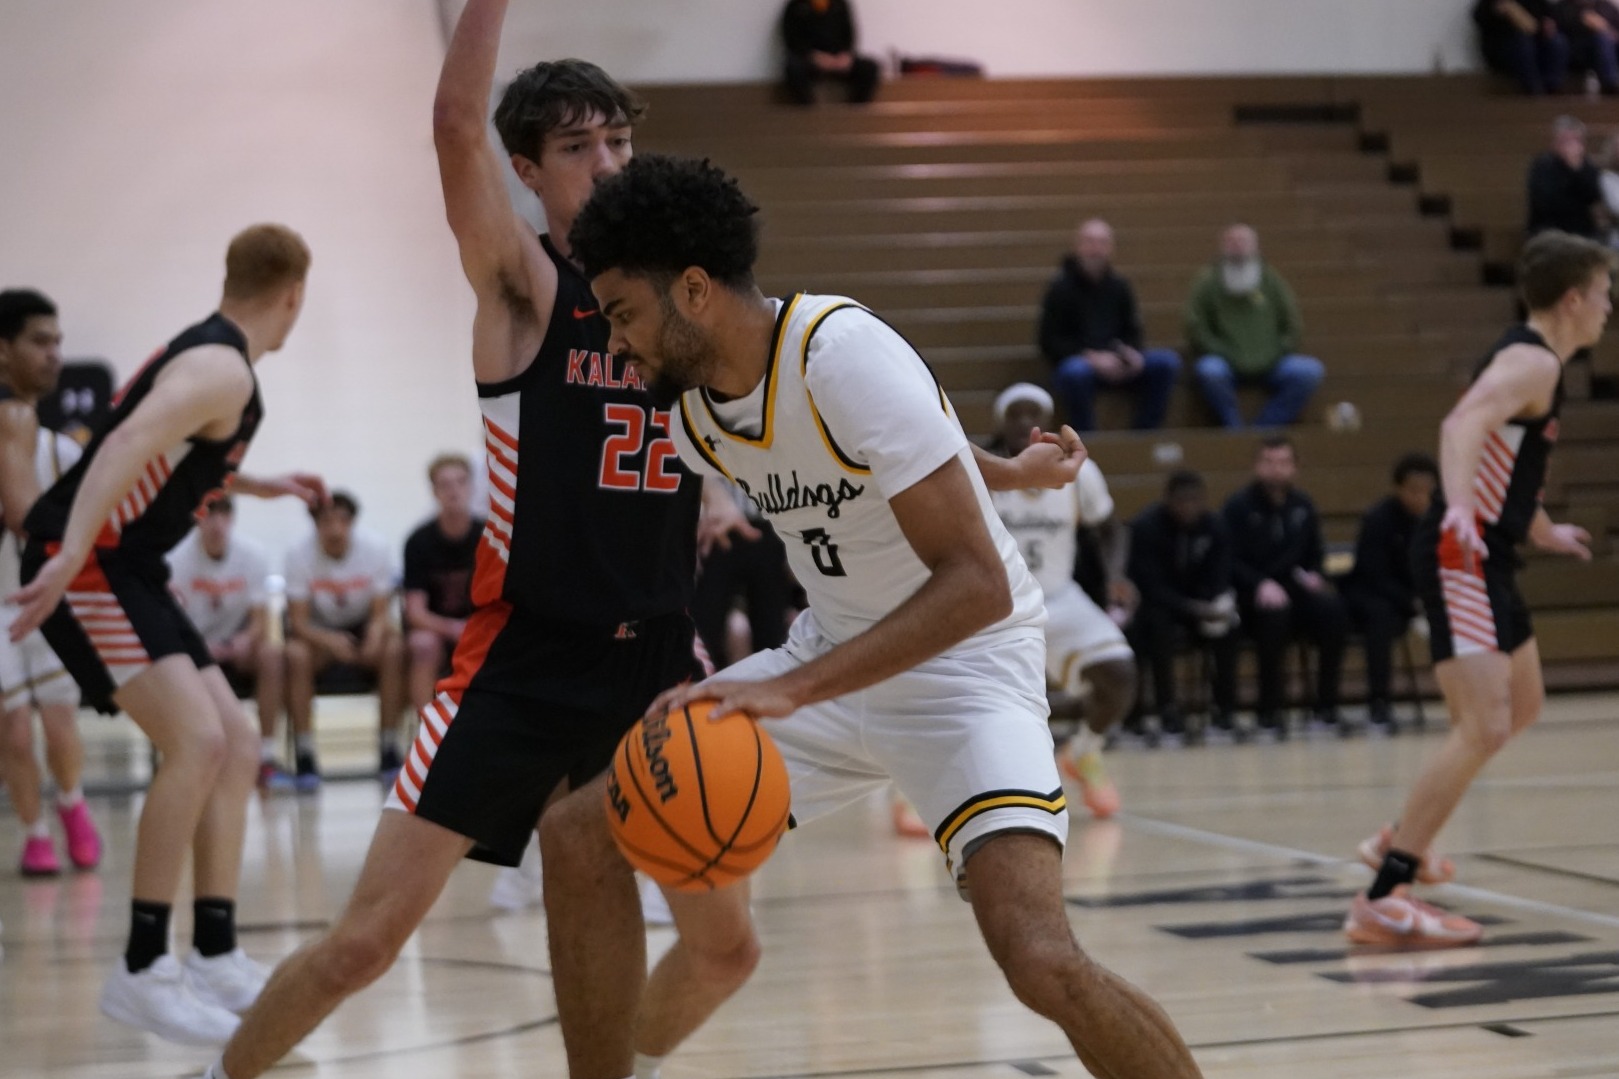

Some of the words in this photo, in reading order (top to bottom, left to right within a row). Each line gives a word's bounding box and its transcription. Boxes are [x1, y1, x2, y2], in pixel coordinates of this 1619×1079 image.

[567, 348, 648, 391] KALA
[598, 402, 682, 492] 22
[799, 527, 847, 577] 0
